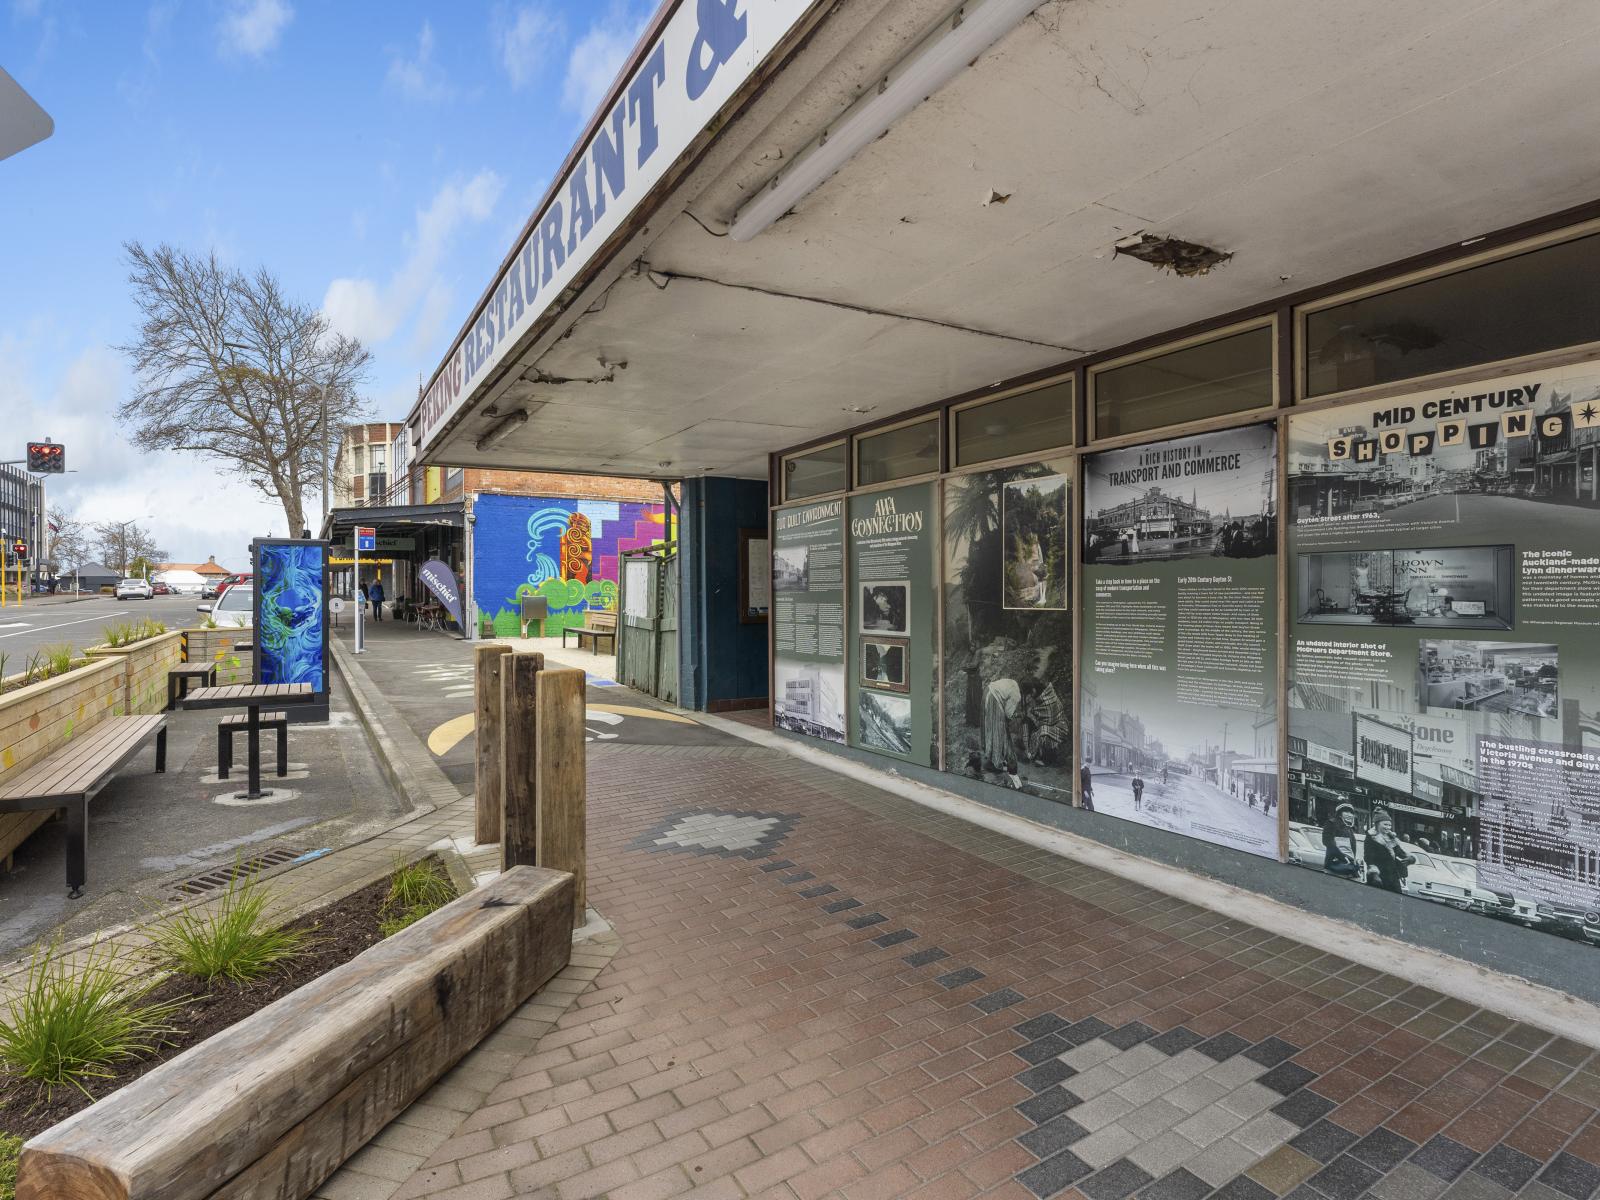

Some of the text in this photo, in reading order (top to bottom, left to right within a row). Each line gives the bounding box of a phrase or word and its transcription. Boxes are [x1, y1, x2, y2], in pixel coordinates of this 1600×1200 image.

[420, 0, 748, 439] PEKING RESTAURANT &
[1373, 383, 1541, 428] MID CENTURY
[1332, 414, 1564, 462] SHOPPING
[1139, 444, 1202, 466] A RICH HISTORY IN
[1109, 453, 1241, 487] TRANSPORT AND COMMERCE
[802, 500, 842, 524] ENVIRONMENT
[875, 496, 896, 517] AWA
[851, 509, 924, 538] CONNECTION
[1522, 557, 1600, 566] Auckland-made
[1542, 549, 1573, 558] iconic
[1522, 567, 1544, 576] Lynn
[421, 568, 458, 604] mischief
[1328, 647, 1369, 656] Department
[1370, 650, 1393, 658] Store.
[1480, 740, 1595, 761] The bustling crossroads
[1480, 748, 1517, 759] Victoria
[1519, 753, 1554, 764] Avenue
[1555, 759, 1574, 767] and
[1490, 758, 1506, 766] the
[1507, 760, 1534, 770] 1970s
